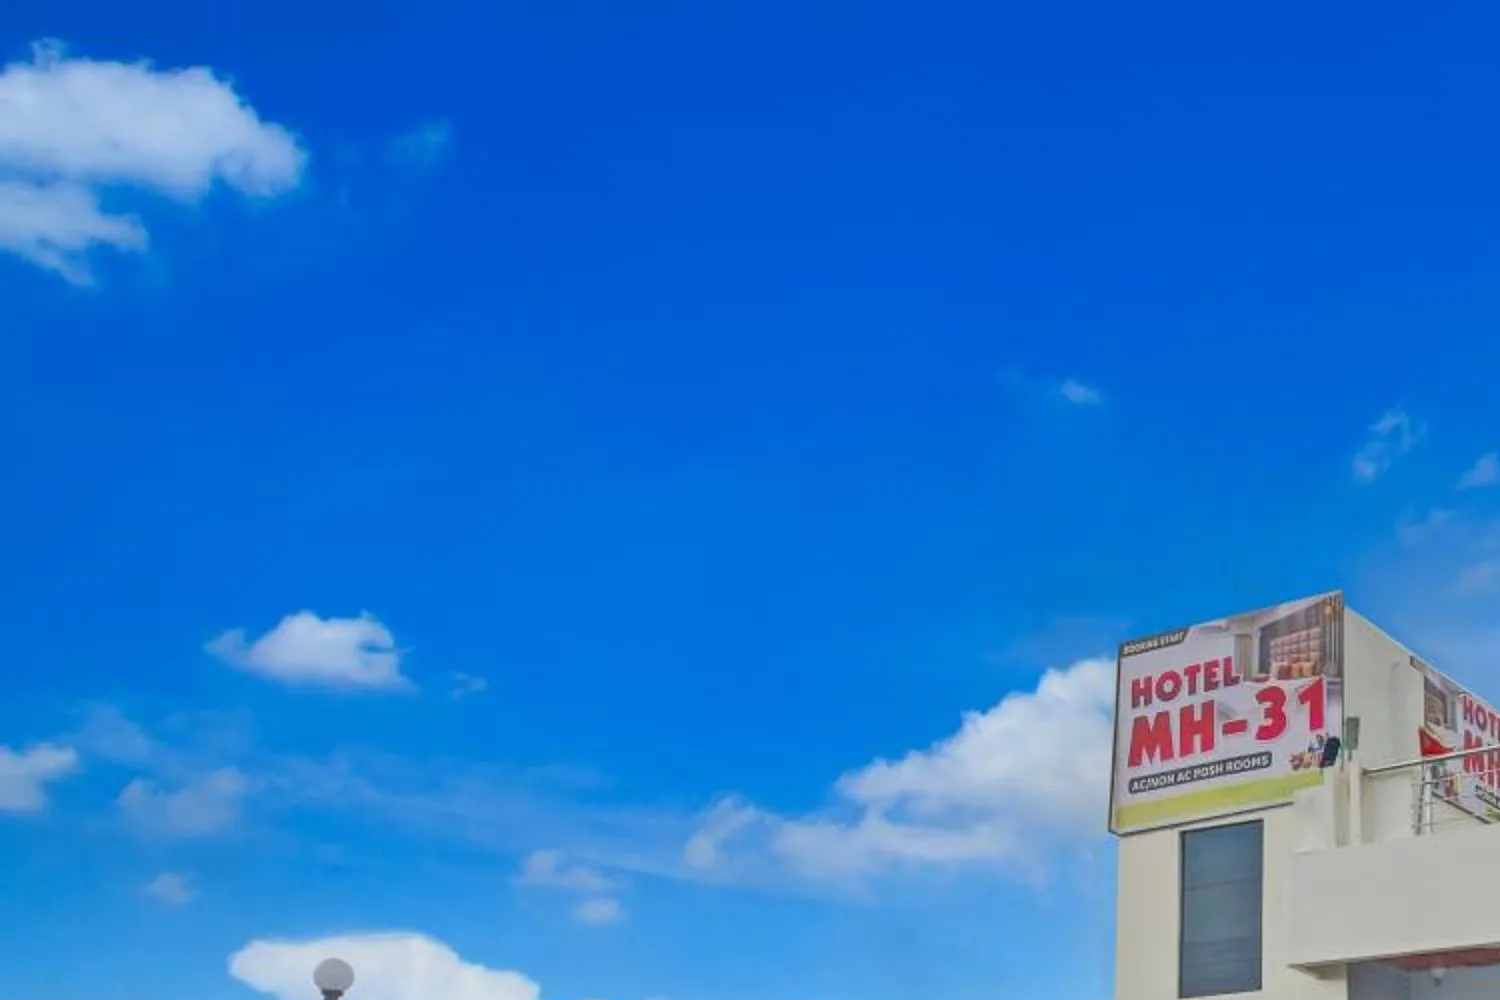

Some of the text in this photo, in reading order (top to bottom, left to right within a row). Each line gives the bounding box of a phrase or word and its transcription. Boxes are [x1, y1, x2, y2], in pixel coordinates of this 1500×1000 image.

[1131, 656, 1241, 709] HOTEL
[1127, 677, 1325, 768] MH-31
[1176, 770, 1192, 783] AC
[1193, 765, 1223, 779] POSH
[1225, 755, 1270, 772] ROOMS
